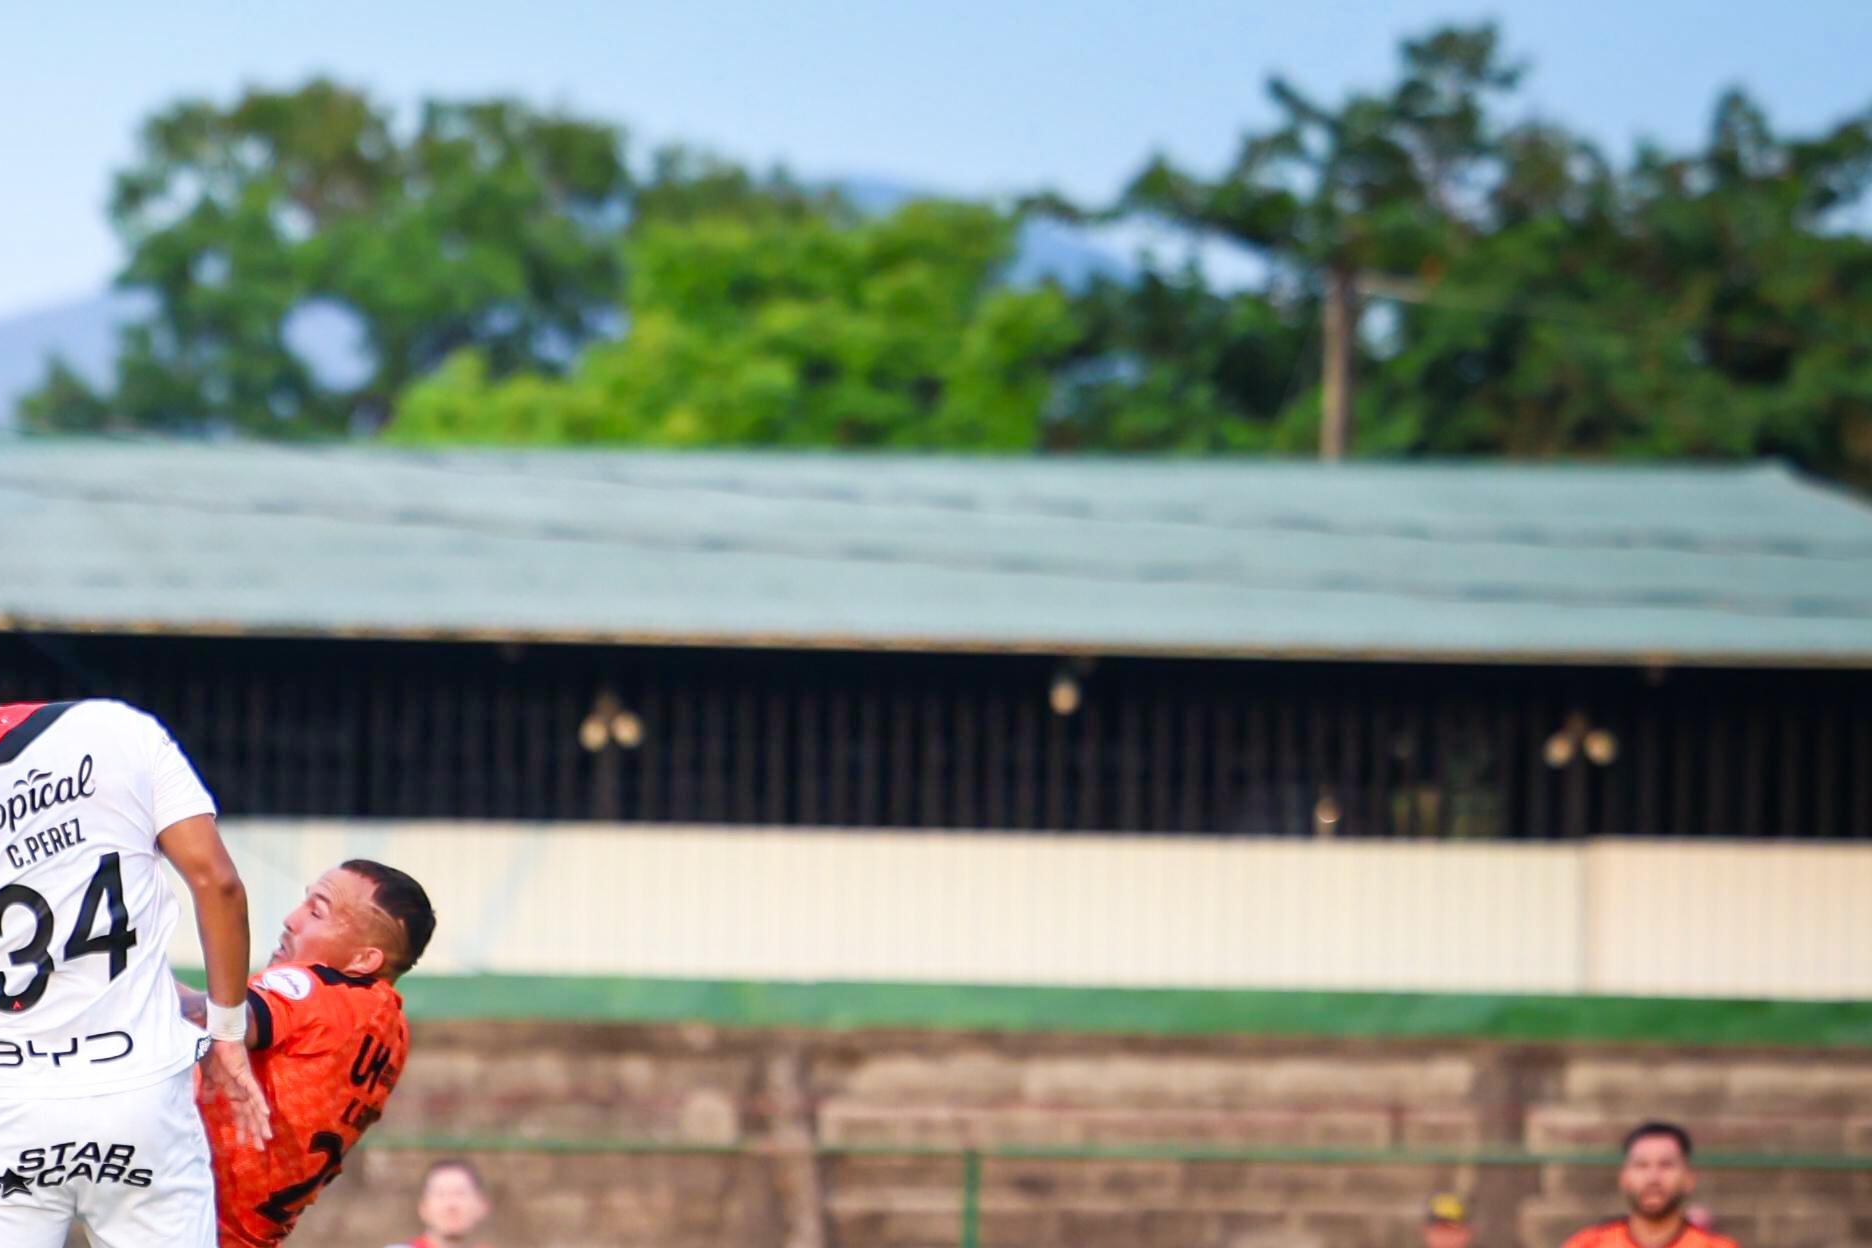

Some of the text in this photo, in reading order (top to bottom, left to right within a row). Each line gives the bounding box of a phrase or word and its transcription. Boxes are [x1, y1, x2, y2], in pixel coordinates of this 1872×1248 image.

[6, 818, 87, 869] C.PEREZ
[17, 1141, 136, 1172] STAR
[36, 1162, 153, 1188] CARS
[256, 1131, 344, 1230] 2
